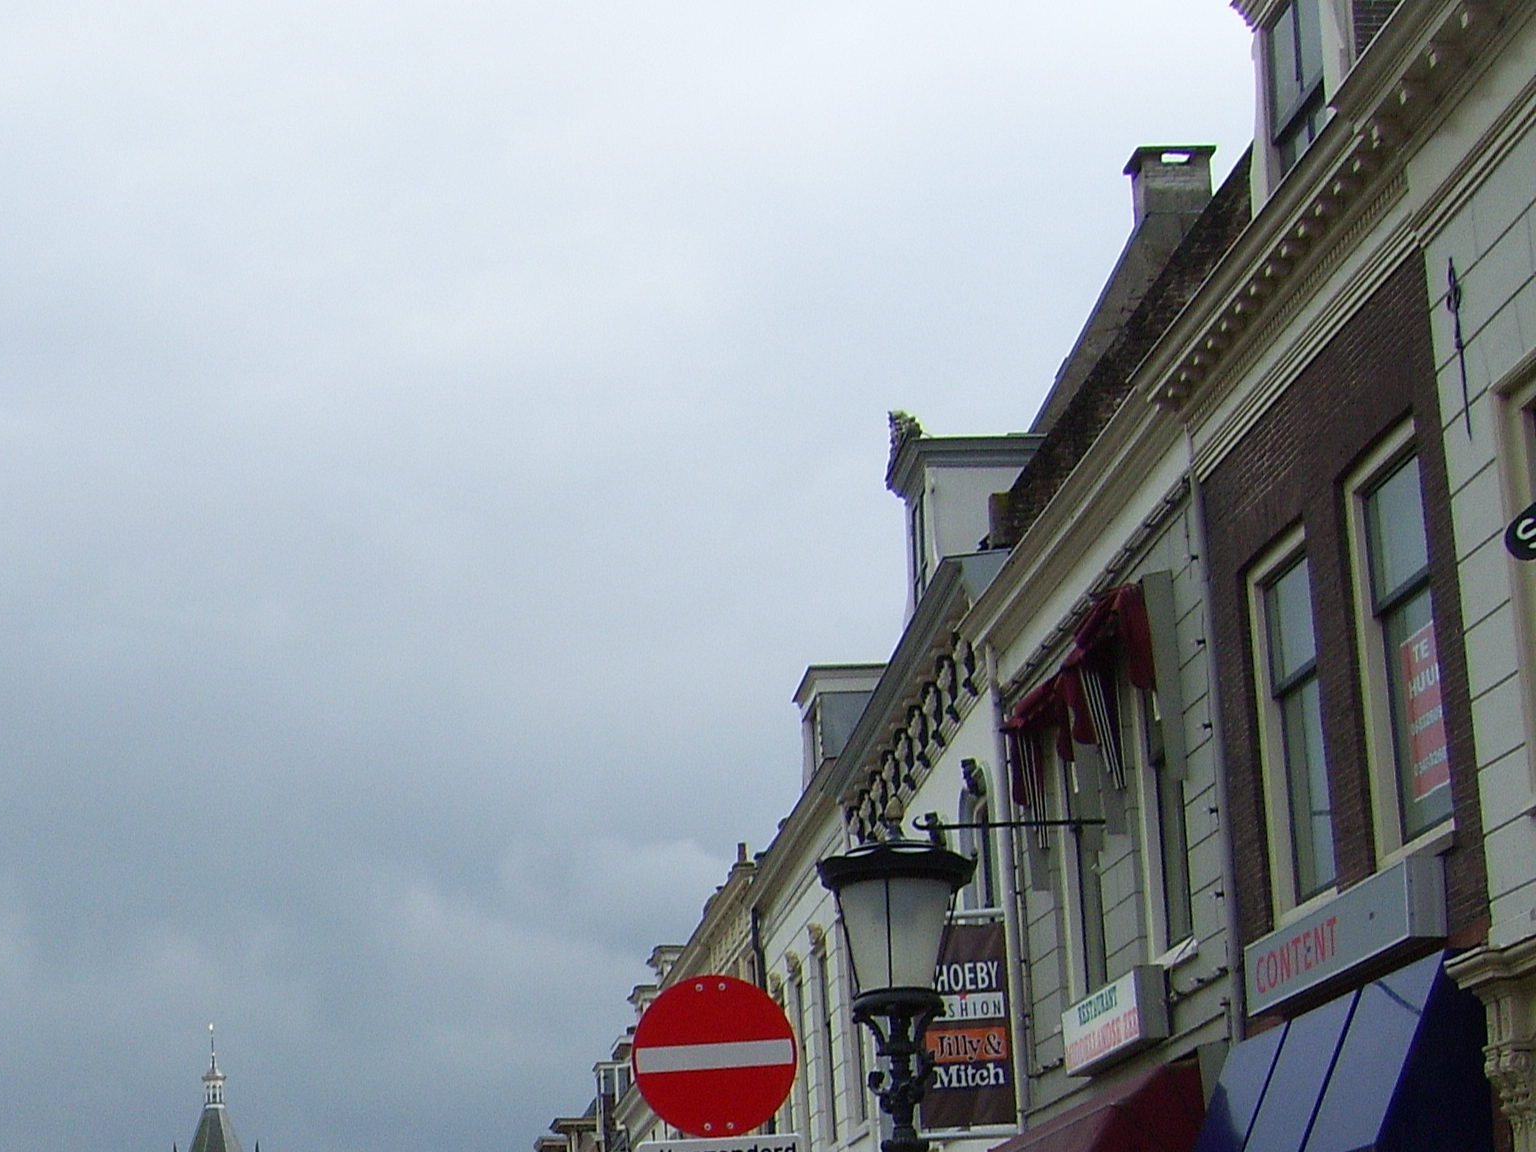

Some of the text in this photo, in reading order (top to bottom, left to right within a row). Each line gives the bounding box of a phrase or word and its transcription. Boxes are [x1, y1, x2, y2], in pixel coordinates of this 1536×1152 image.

[1413, 638, 1429, 663] TE
[1256, 916, 1338, 994] CONTENT
[933, 961, 999, 992] HOEBY
[948, 999, 1001, 1018] SHION
[1077, 985, 1117, 1026] RESTAURANT
[936, 1033, 1001, 1061] Jilly &
[932, 1062, 1005, 1089] Mitch
